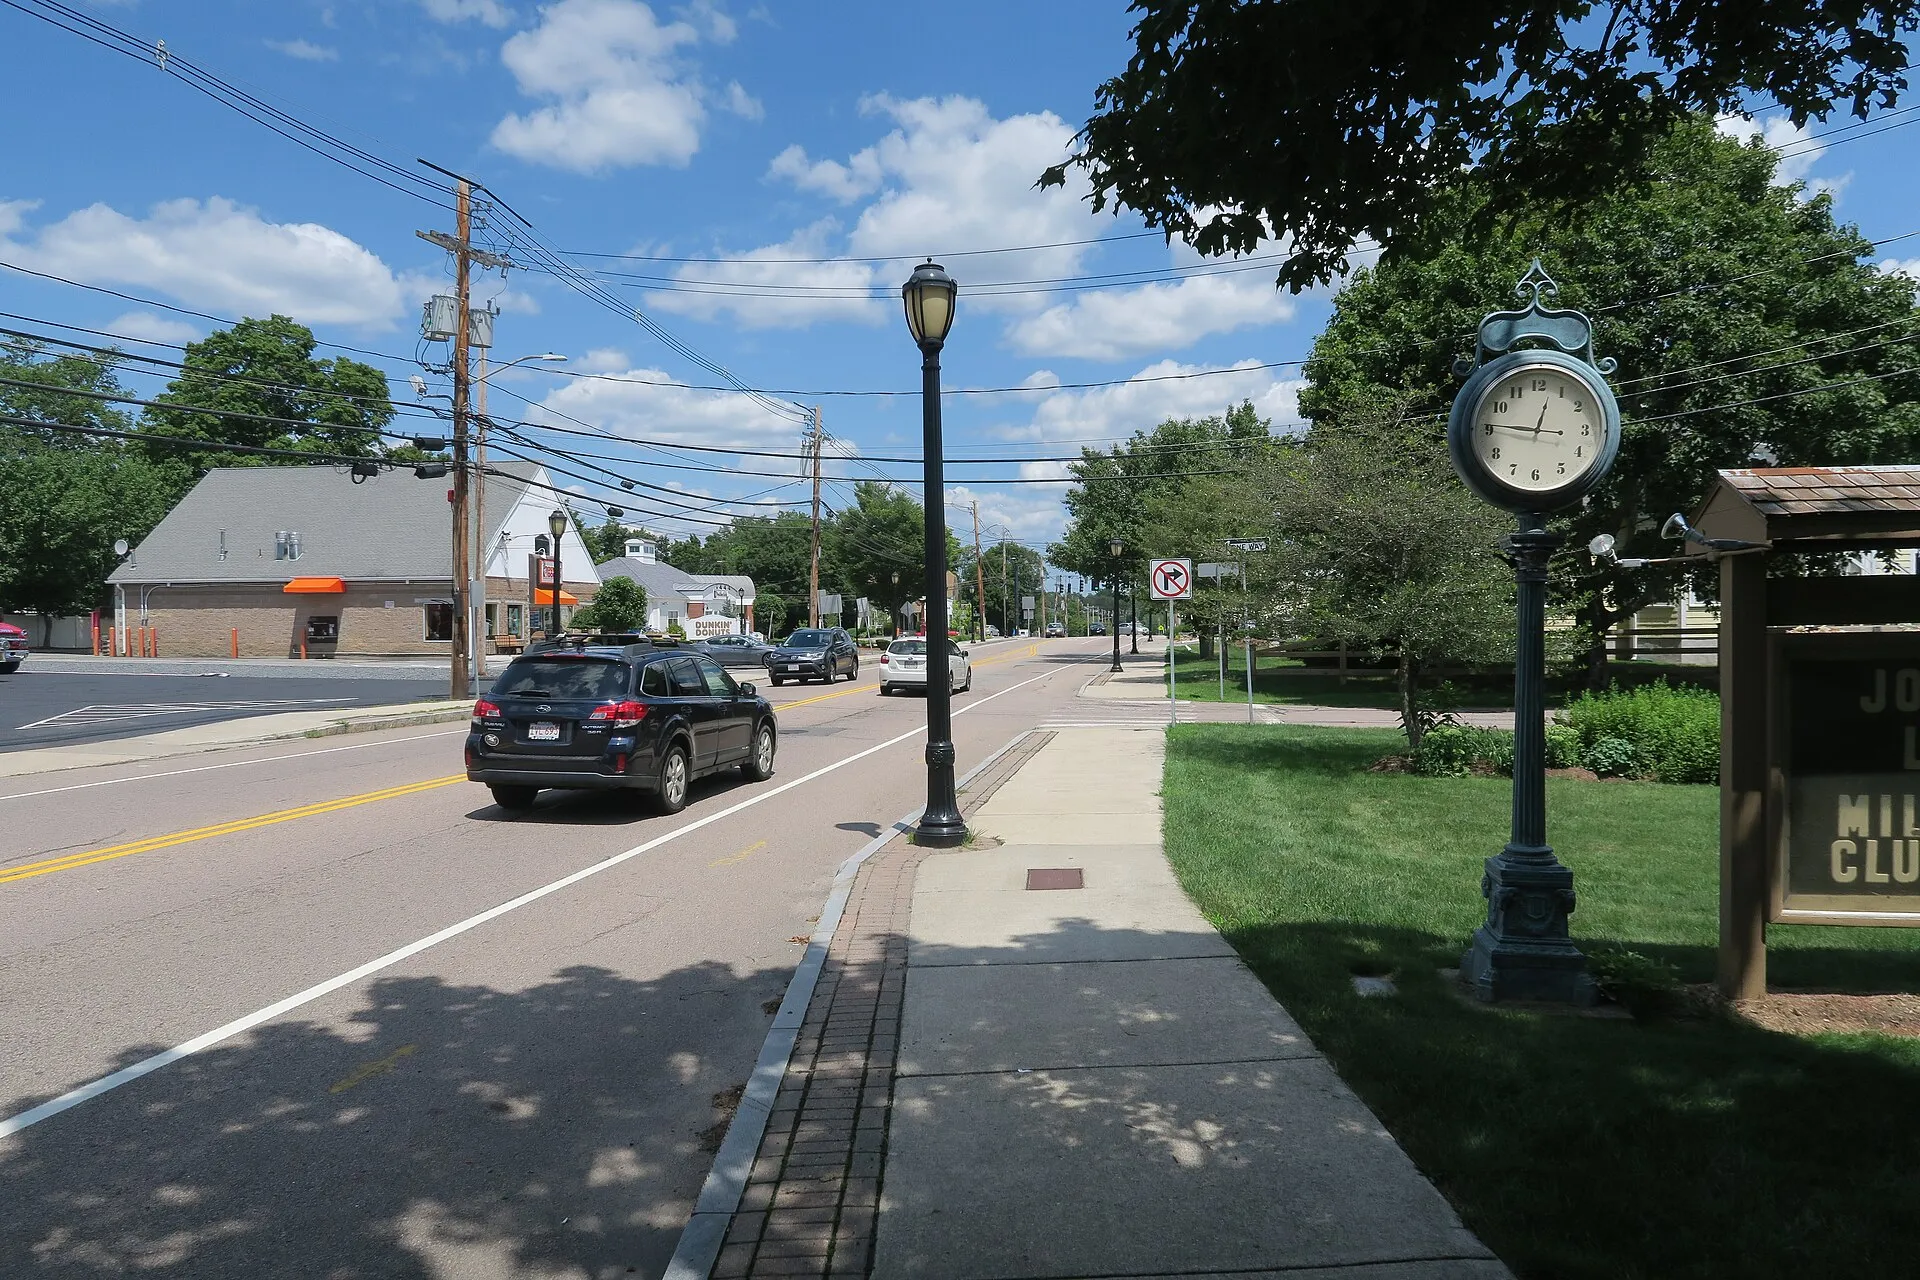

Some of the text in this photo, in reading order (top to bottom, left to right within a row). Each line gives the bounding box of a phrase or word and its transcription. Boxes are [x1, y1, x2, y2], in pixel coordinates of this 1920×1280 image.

[1531, 380, 1546, 391] 12
[1510, 387, 1522, 398] 11
[1559, 387, 1564, 398] 1
[1493, 402, 1508, 413] 10
[1574, 401, 1582, 412] 2
[1485, 425, 1494, 436] 9
[1581, 424, 1589, 436] 3
[1492, 448, 1500, 459] 8
[1574, 446, 1582, 457] 4
[1510, 464, 1517, 475] 7
[1557, 463, 1565, 474] 5
[1531, 469, 1540, 481] 6
[1831, 839, 1919, 883] CLU
